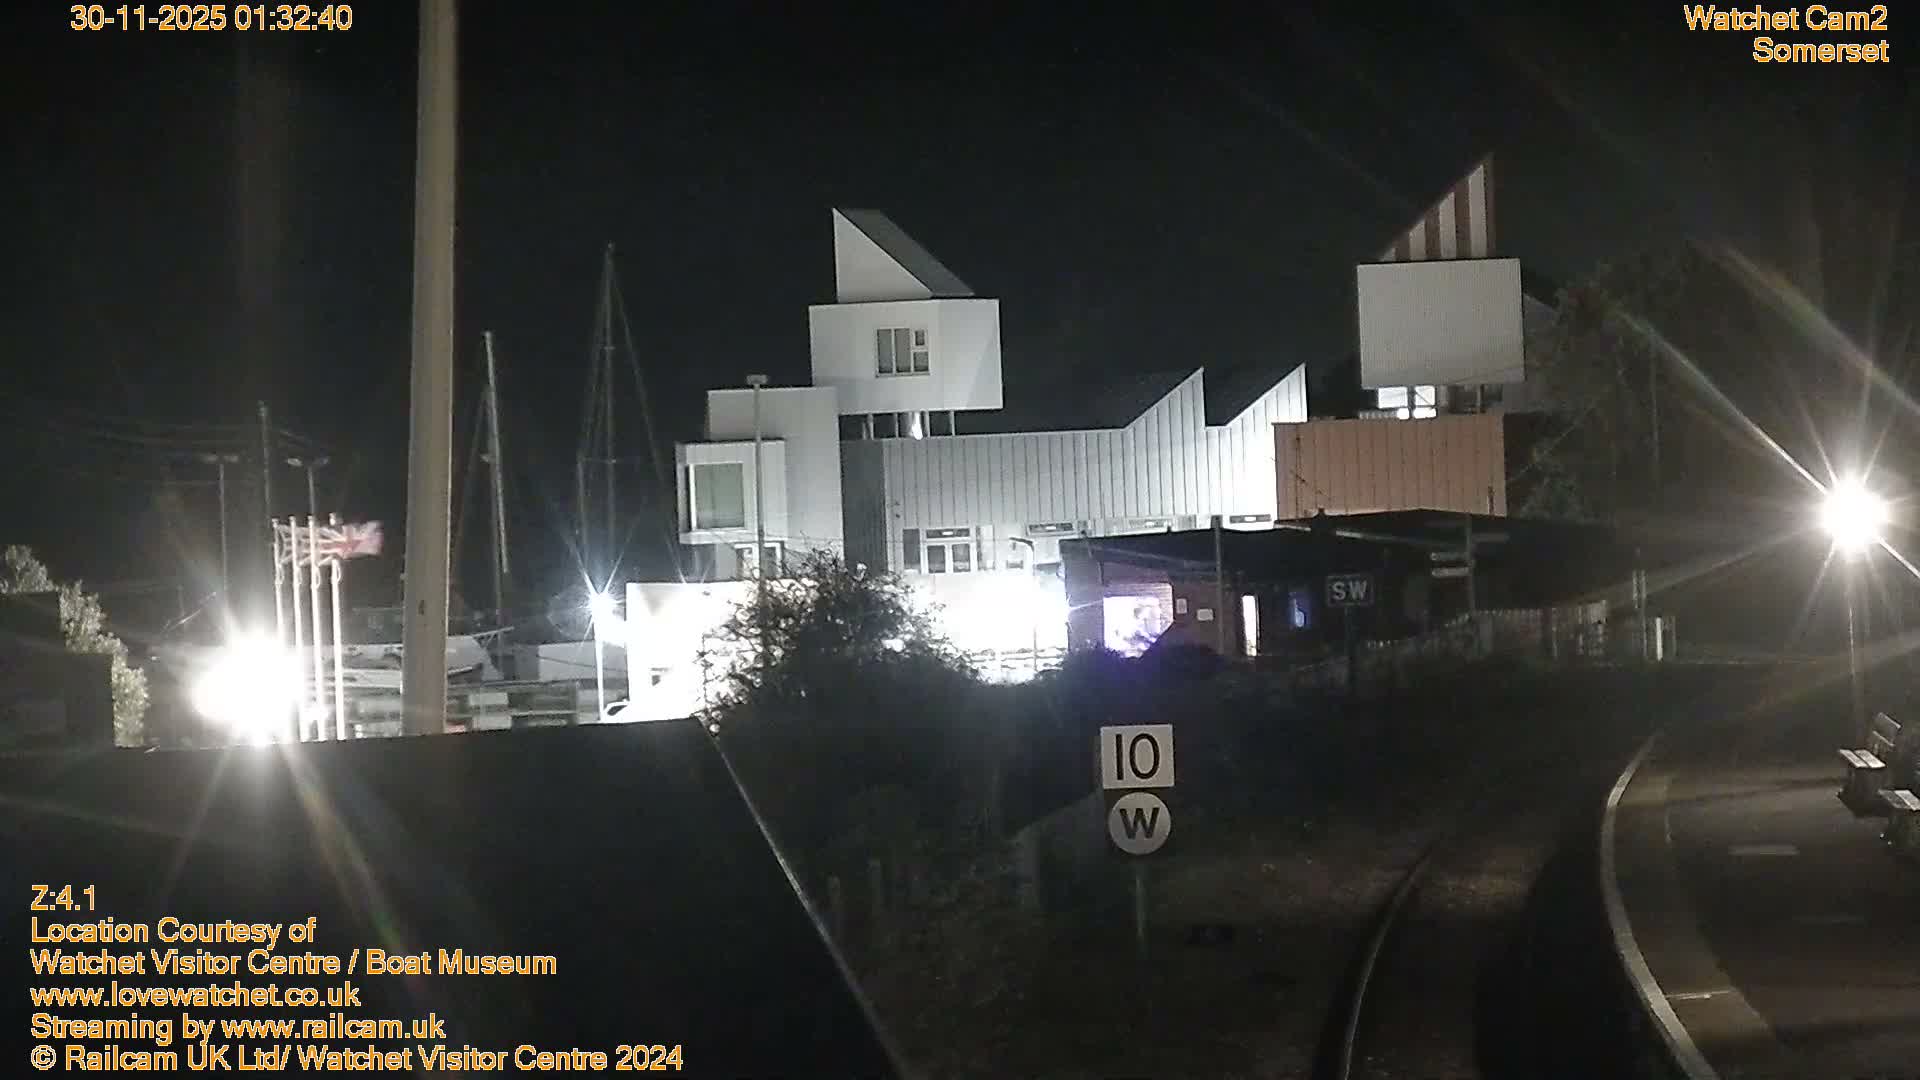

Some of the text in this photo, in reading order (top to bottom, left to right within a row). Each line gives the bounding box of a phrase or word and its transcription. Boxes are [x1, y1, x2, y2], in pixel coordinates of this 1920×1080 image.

[1332, 580, 1368, 600] SW
[1115, 733, 1160, 780] 10
[1119, 807, 1160, 839] W
